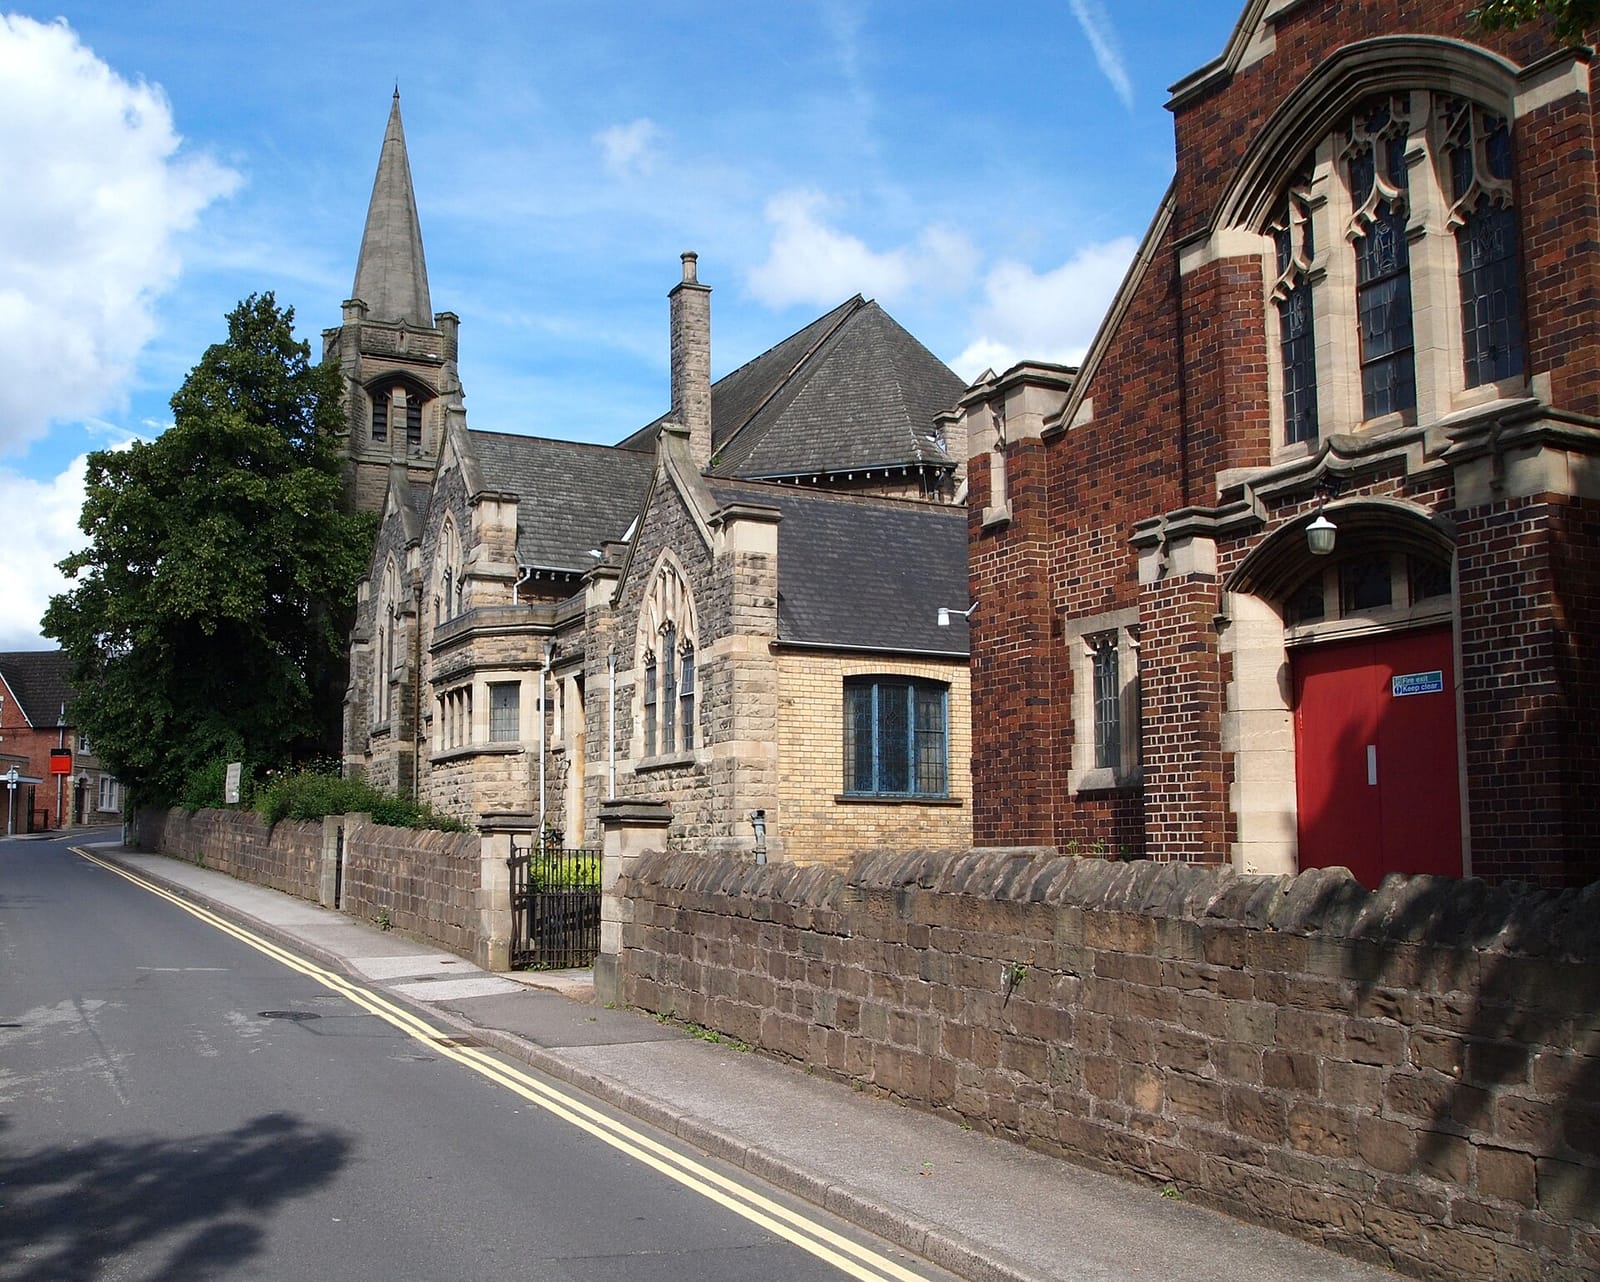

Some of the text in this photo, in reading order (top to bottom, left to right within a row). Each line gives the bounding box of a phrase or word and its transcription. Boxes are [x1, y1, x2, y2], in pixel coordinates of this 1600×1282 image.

[1415, 675, 1428, 683] exit
[1402, 682, 1438, 692] Keep clear
